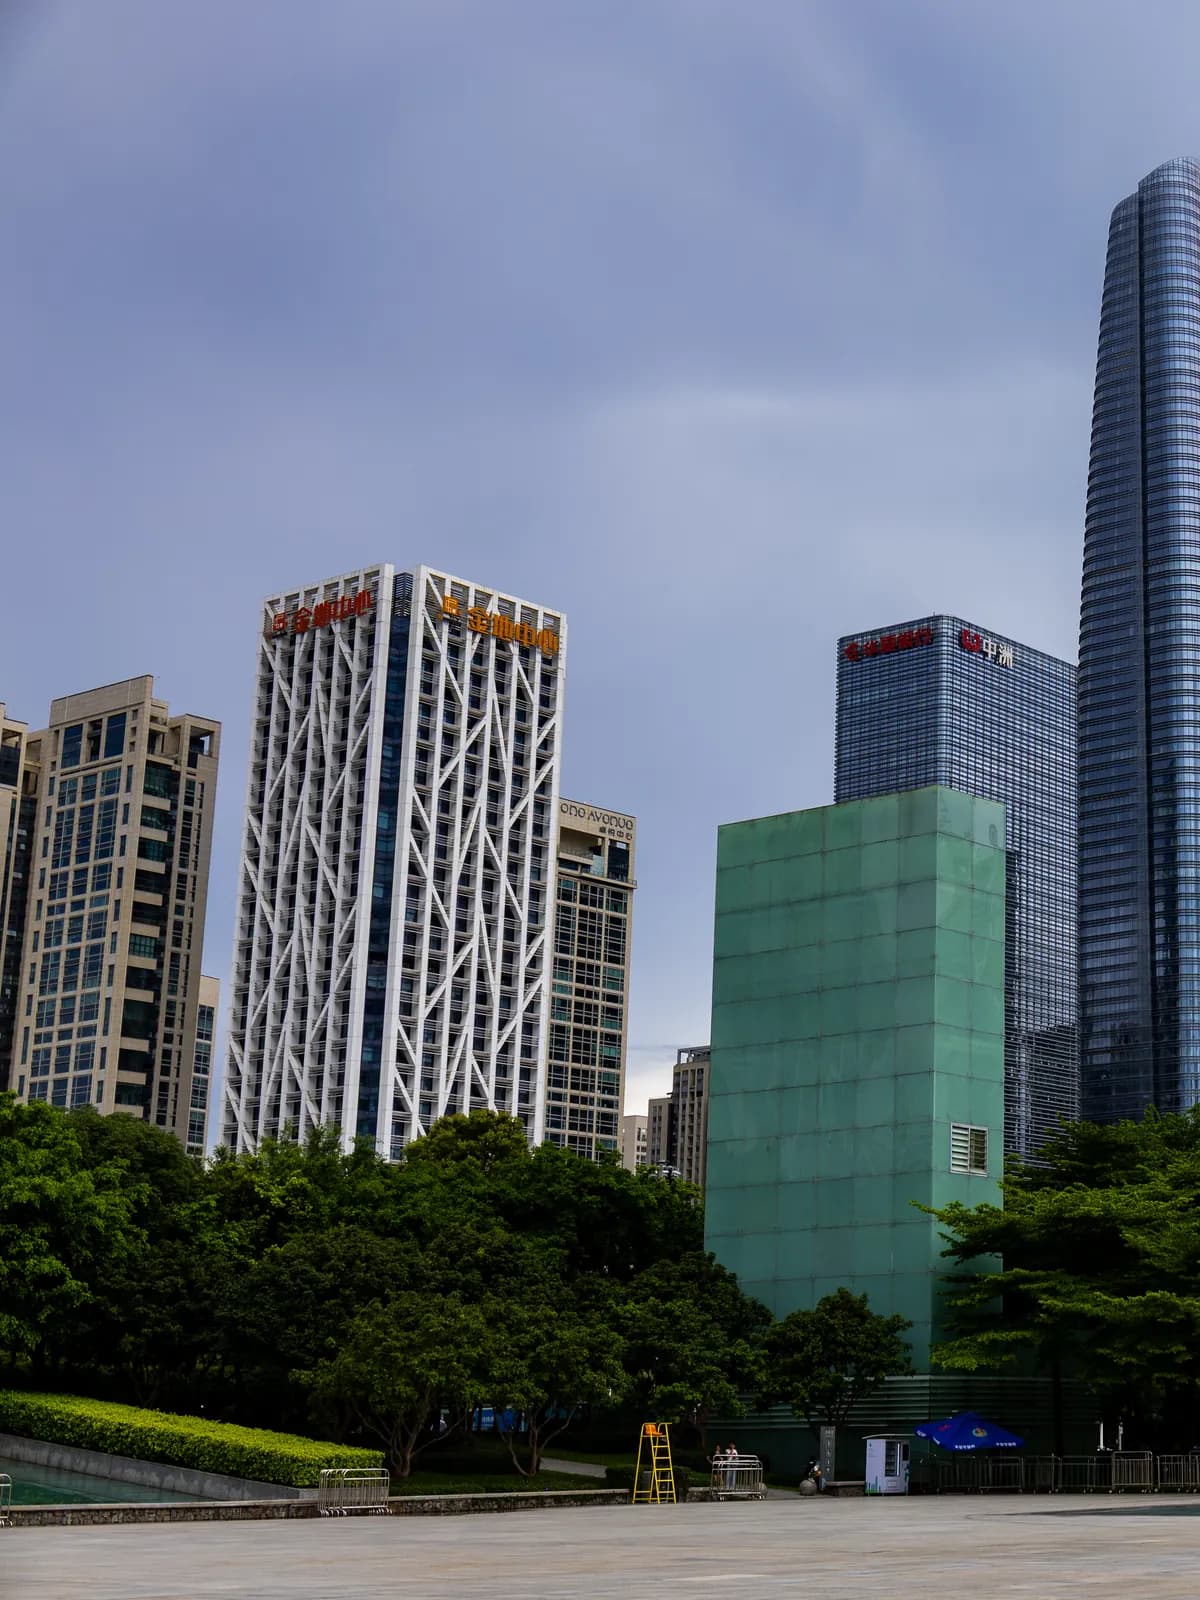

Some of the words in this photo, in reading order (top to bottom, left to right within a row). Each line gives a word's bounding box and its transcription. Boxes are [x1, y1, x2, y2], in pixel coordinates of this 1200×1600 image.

[467, 607, 559, 655] 金地中心
[983, 637, 1013, 668] 中洲
